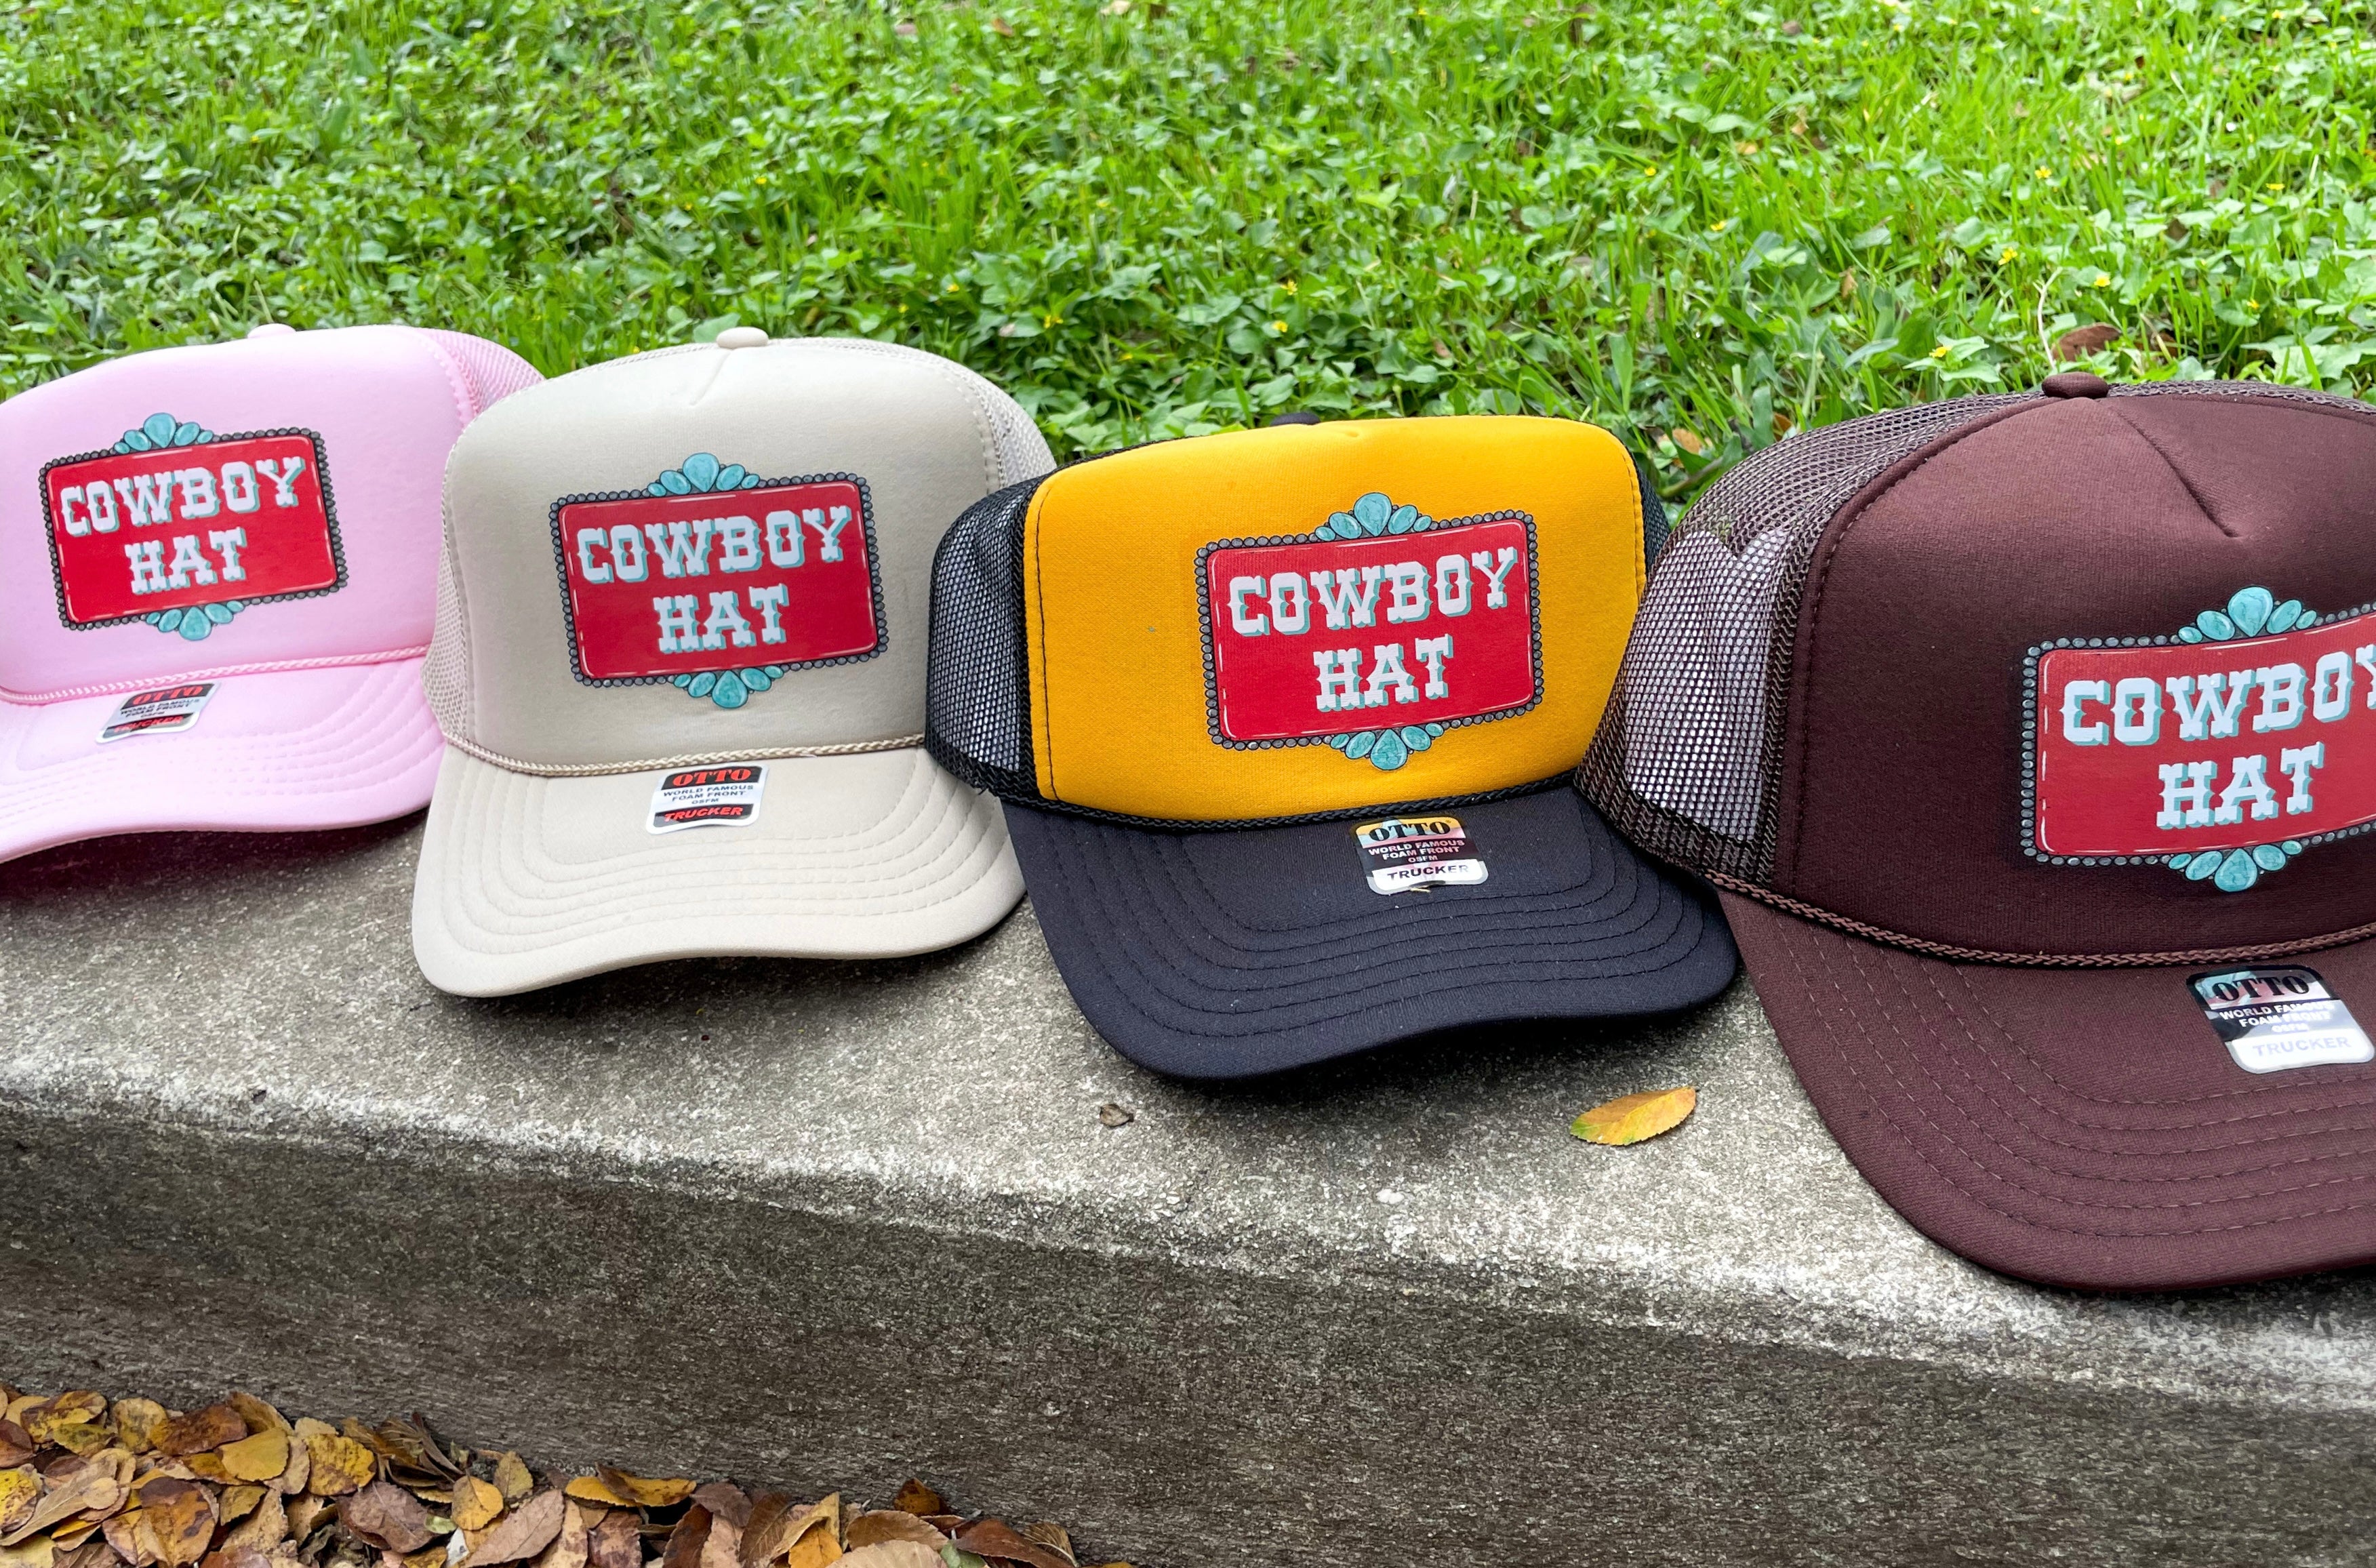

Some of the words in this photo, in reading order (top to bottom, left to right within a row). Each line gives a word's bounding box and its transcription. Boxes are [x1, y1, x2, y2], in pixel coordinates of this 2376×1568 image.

[60, 456, 306, 537] COWBOY
[577, 505, 851, 584] COWBOY
[124, 527, 247, 595] HAT
[1226, 546, 1518, 636] COWBOY
[653, 583, 789, 654] HAT
[1312, 633, 1454, 712] HAT
[133, 685, 203, 705] OTTO
[114, 716, 184, 732] TRUCKER
[672, 768, 752, 786] OTTO
[2156, 741, 2324, 830] HAT
[664, 788, 703, 797] WORLD
[672, 793, 703, 801] FOAM
[664, 807, 744, 822] TRUCKER
[1369, 821, 1451, 841] OTTO
[1368, 843, 1412, 856] WORLD
[1415, 839, 1465, 849] FAMOUS
[1382, 849, 1417, 860] FOAM
[1419, 846, 1460, 855] FRONT
[1387, 864, 1468, 881] TRUCKER
[2212, 976, 2310, 1001] OTTO
[2219, 1006, 2272, 1020] WORLD
[2276, 1000, 2335, 1013] FAMOUS
[2239, 1014, 2280, 1027] FOAM
[2281, 1011, 2332, 1022] FRONT
[2253, 1037, 2351, 1056] TRUCKER
